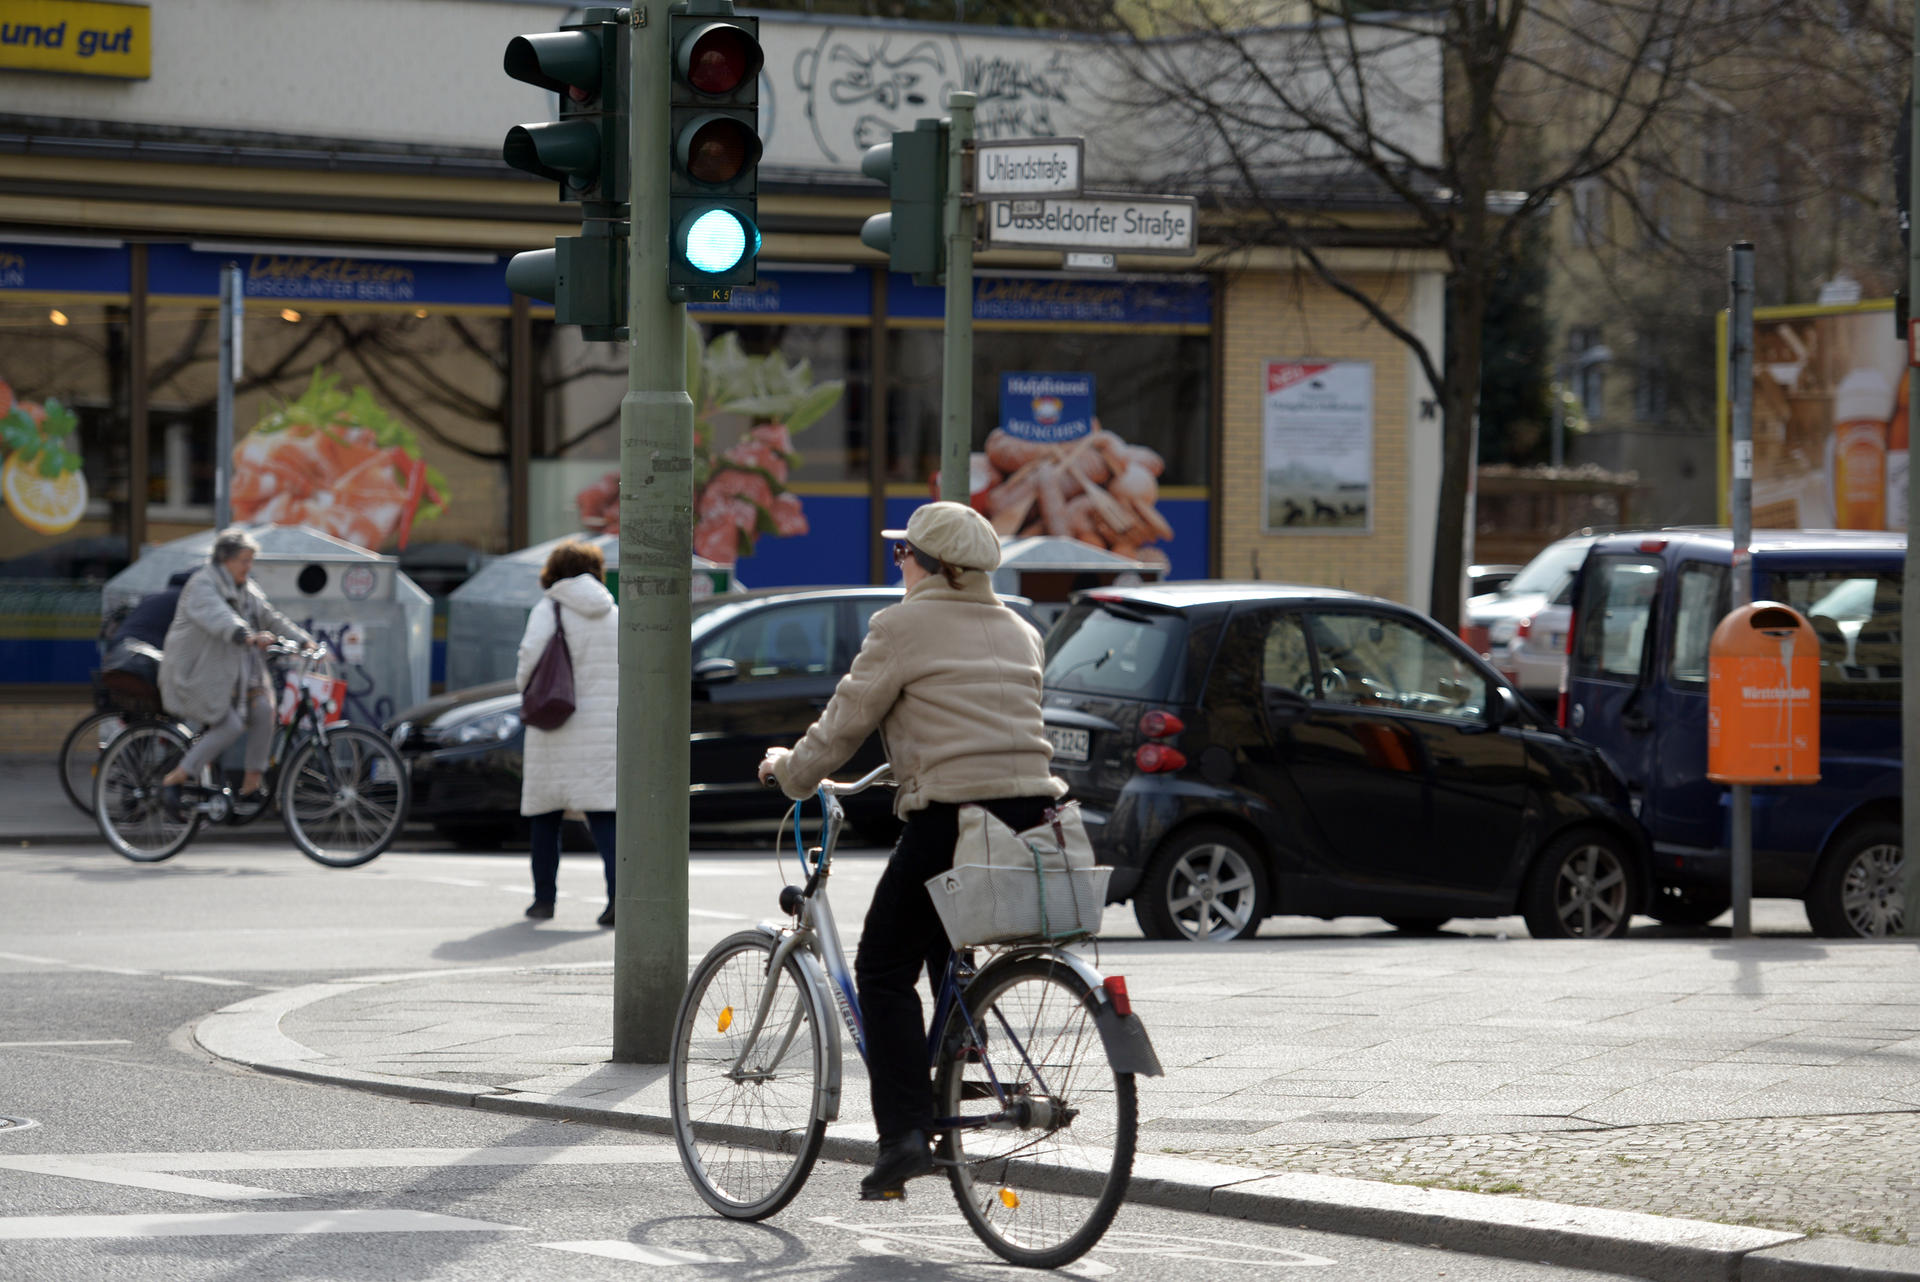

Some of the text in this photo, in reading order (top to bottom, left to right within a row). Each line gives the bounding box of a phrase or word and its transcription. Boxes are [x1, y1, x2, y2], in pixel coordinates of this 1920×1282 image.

[1, 20, 133, 58] und gut
[986, 152, 1068, 185] Uhlandstraße
[1123, 207, 1186, 242] Straße
[356, 281, 415, 300] BERLIN
[712, 289, 720, 300] K
